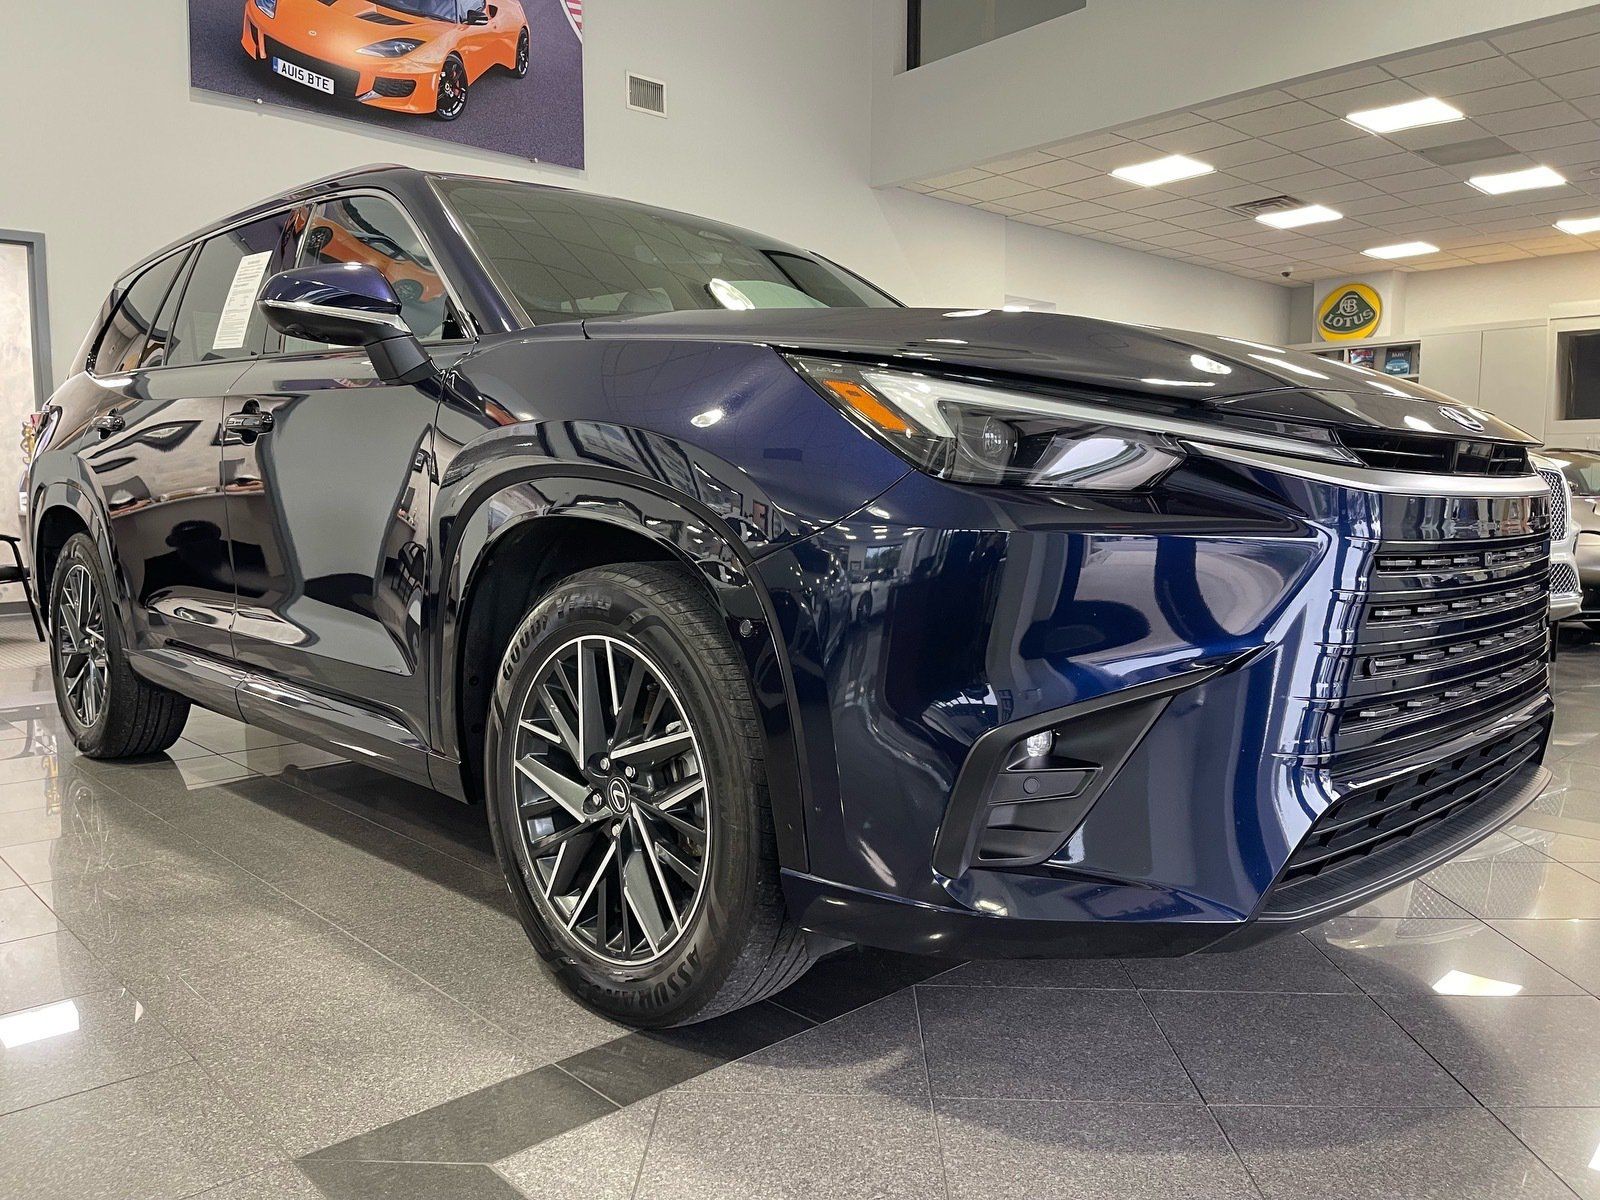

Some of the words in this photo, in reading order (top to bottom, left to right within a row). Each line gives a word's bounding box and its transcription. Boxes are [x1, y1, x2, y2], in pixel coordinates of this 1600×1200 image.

[281, 62, 304, 81] AU15
[307, 72, 330, 91] BTE
[1325, 309, 1373, 327] LOTUS
